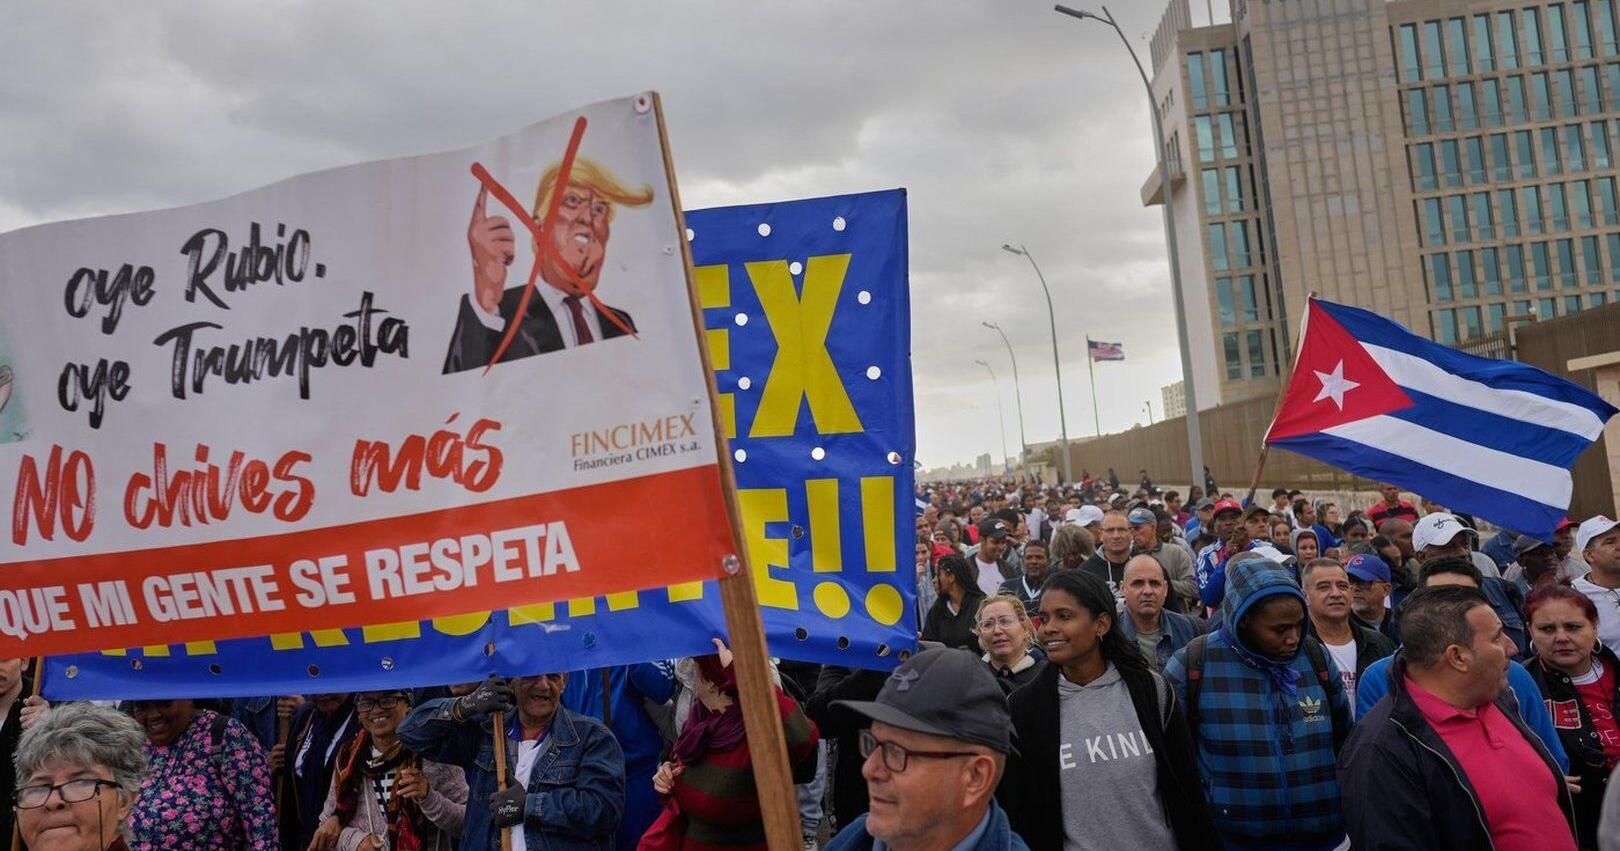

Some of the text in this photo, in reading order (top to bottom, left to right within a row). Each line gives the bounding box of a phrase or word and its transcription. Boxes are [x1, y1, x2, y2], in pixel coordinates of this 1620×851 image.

[64, 222, 326, 335] oye Rubio.
[58, 291, 409, 429] oye Trumpeta
[13, 412, 503, 546] NO chives más
[571, 411, 696, 457] FINCIMEX
[574, 441, 702, 471] Financiera CIMEX s.a.
[0, 585, 76, 641] QUE
[79, 580, 138, 628] MI
[142, 564, 285, 623] GENTE
[289, 555, 355, 608] SE
[365, 520, 581, 600] RESPETA
